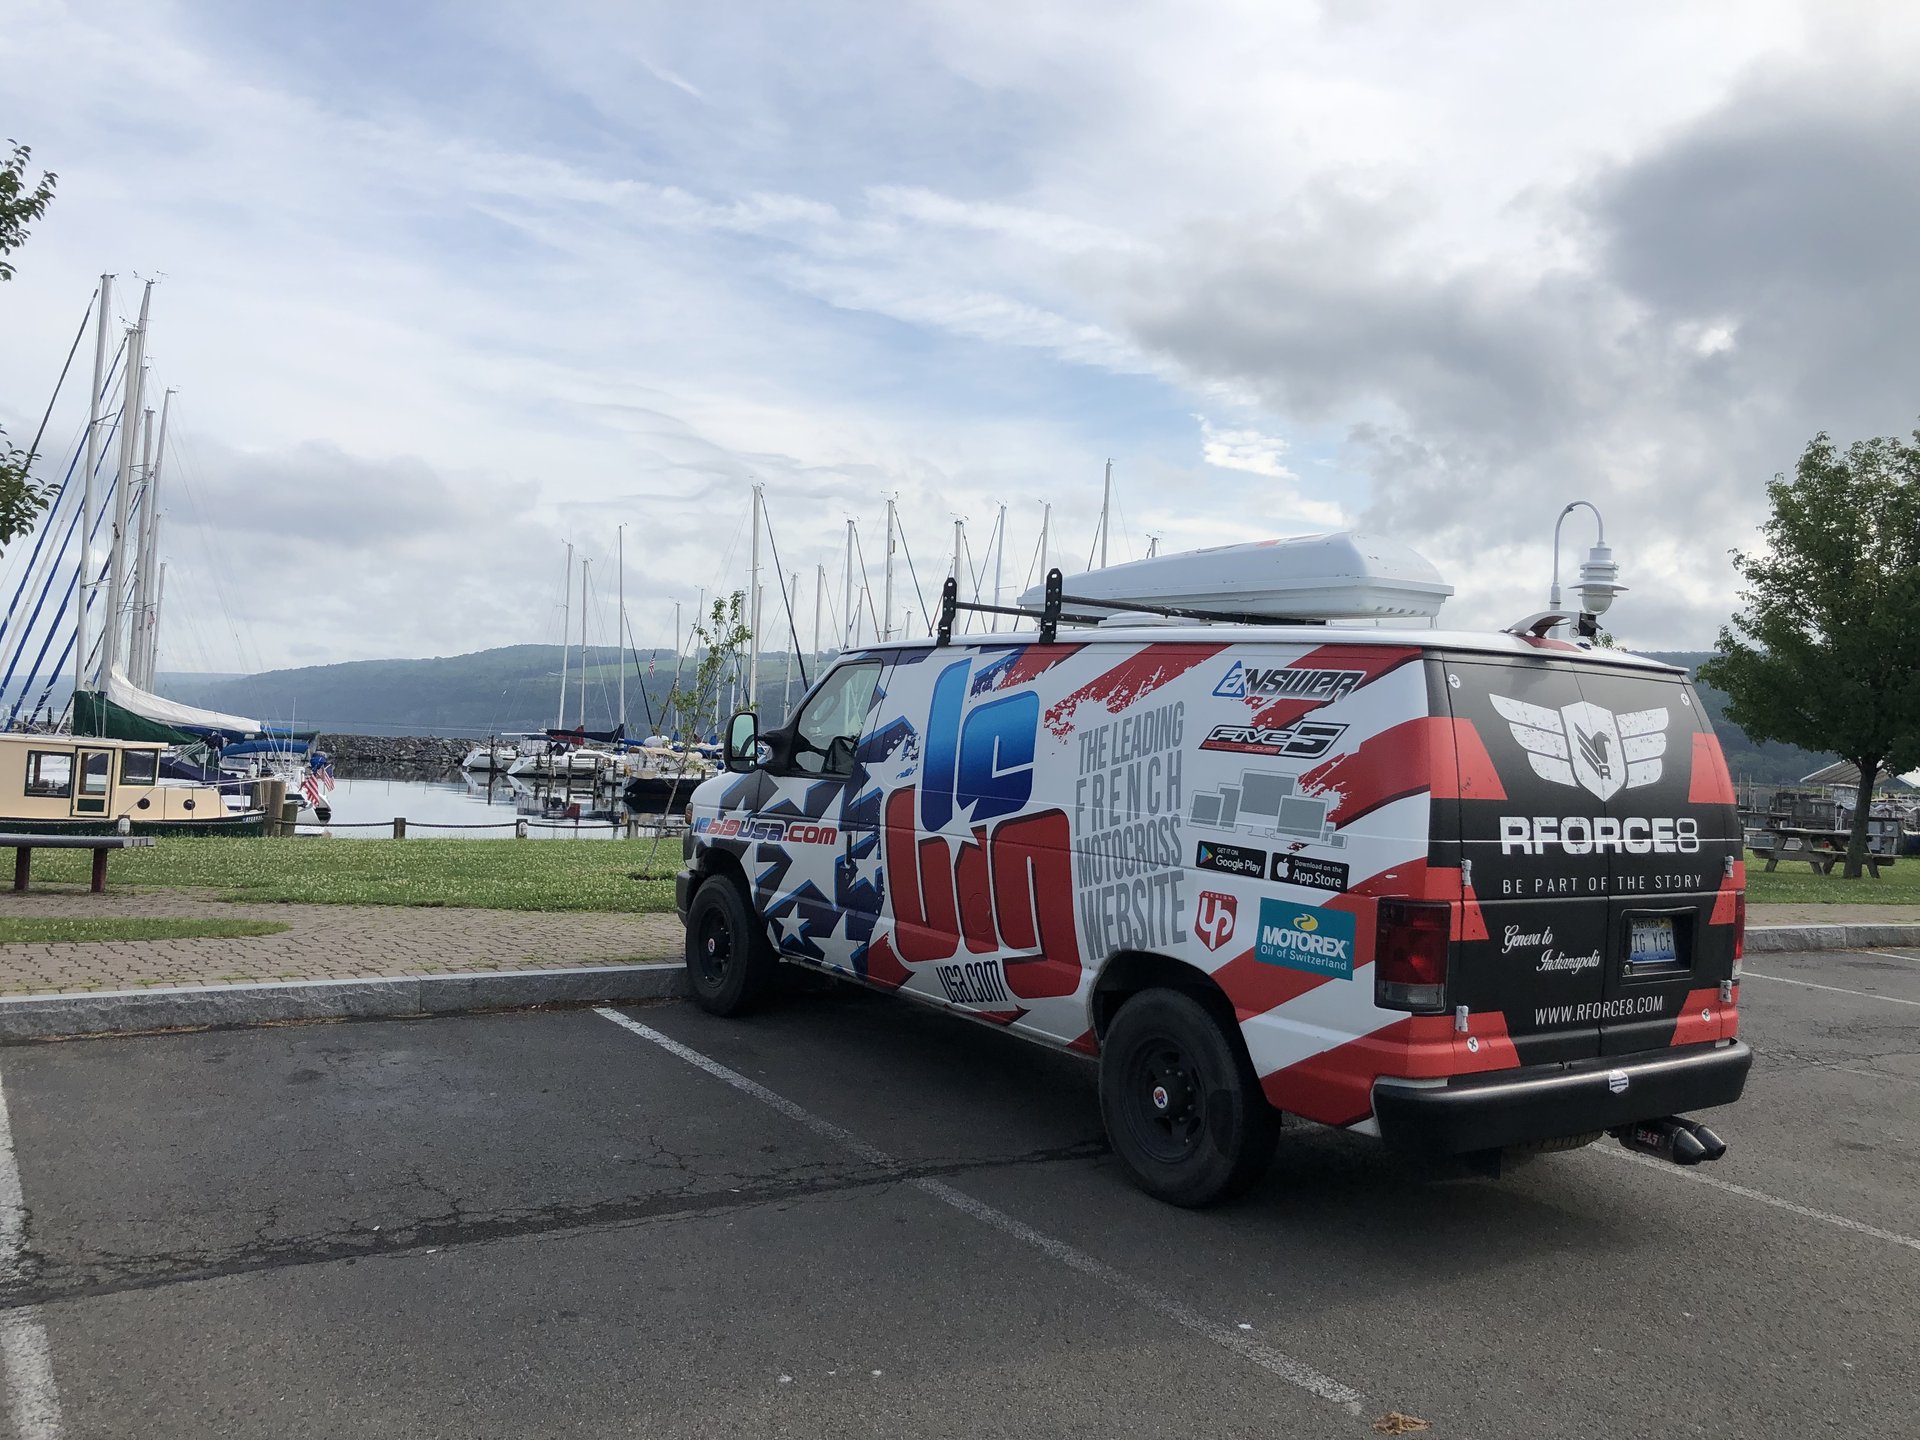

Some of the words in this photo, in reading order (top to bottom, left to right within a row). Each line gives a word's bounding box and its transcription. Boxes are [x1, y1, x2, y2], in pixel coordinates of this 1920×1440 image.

[1078, 721, 1109, 775] THE
[1110, 701, 1185, 766] LEADING
[1075, 750, 1183, 836] FRENCH
[1499, 816, 1699, 855] RFORCE8
[1076, 814, 1182, 889] MOTOCROSS
[1215, 855, 1244, 871] Google
[1244, 860, 1261, 875] Play
[1294, 859, 1323, 870] Download
[1332, 865, 1342, 874] the
[1292, 868, 1314, 885] App
[1314, 872, 1342, 888] Store
[1502, 879, 1523, 894] BE
[1535, 877, 1578, 893] PART
[1588, 876, 1608, 891] OF
[1617, 875, 1645, 890] THE
[1080, 870, 1187, 961] WEBSITE
[1262, 925, 1347, 959] MOTOREX
[1501, 924, 1541, 954] Geneva
[1541, 926, 1553, 945] to
[1260, 944, 1274, 956] Oil
[1276, 948, 1287, 958] of
[1289, 950, 1347, 970] Switzerland
[1535, 948, 1601, 975] Indianapolis
[1535, 995, 1663, 1026] WWW.RFORCE8.COM
